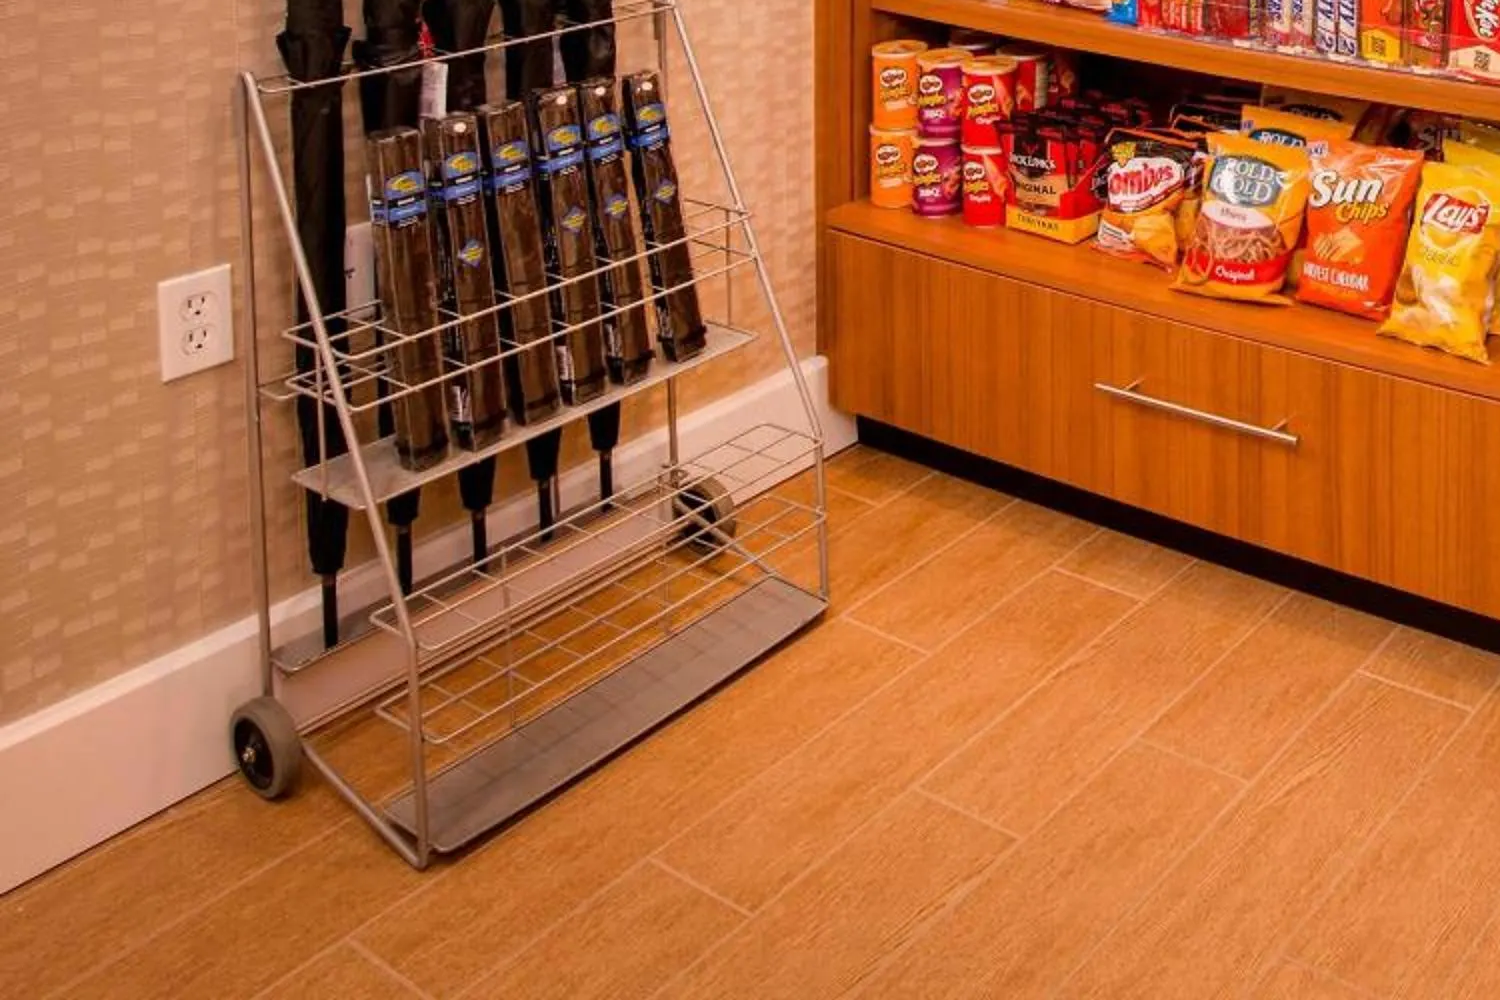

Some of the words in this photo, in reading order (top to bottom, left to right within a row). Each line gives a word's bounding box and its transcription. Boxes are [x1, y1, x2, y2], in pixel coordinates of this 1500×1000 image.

[1322, 33, 1334, 50] 2
[1308, 170, 1384, 207] Sun
[1335, 202, 1390, 225] Chips
